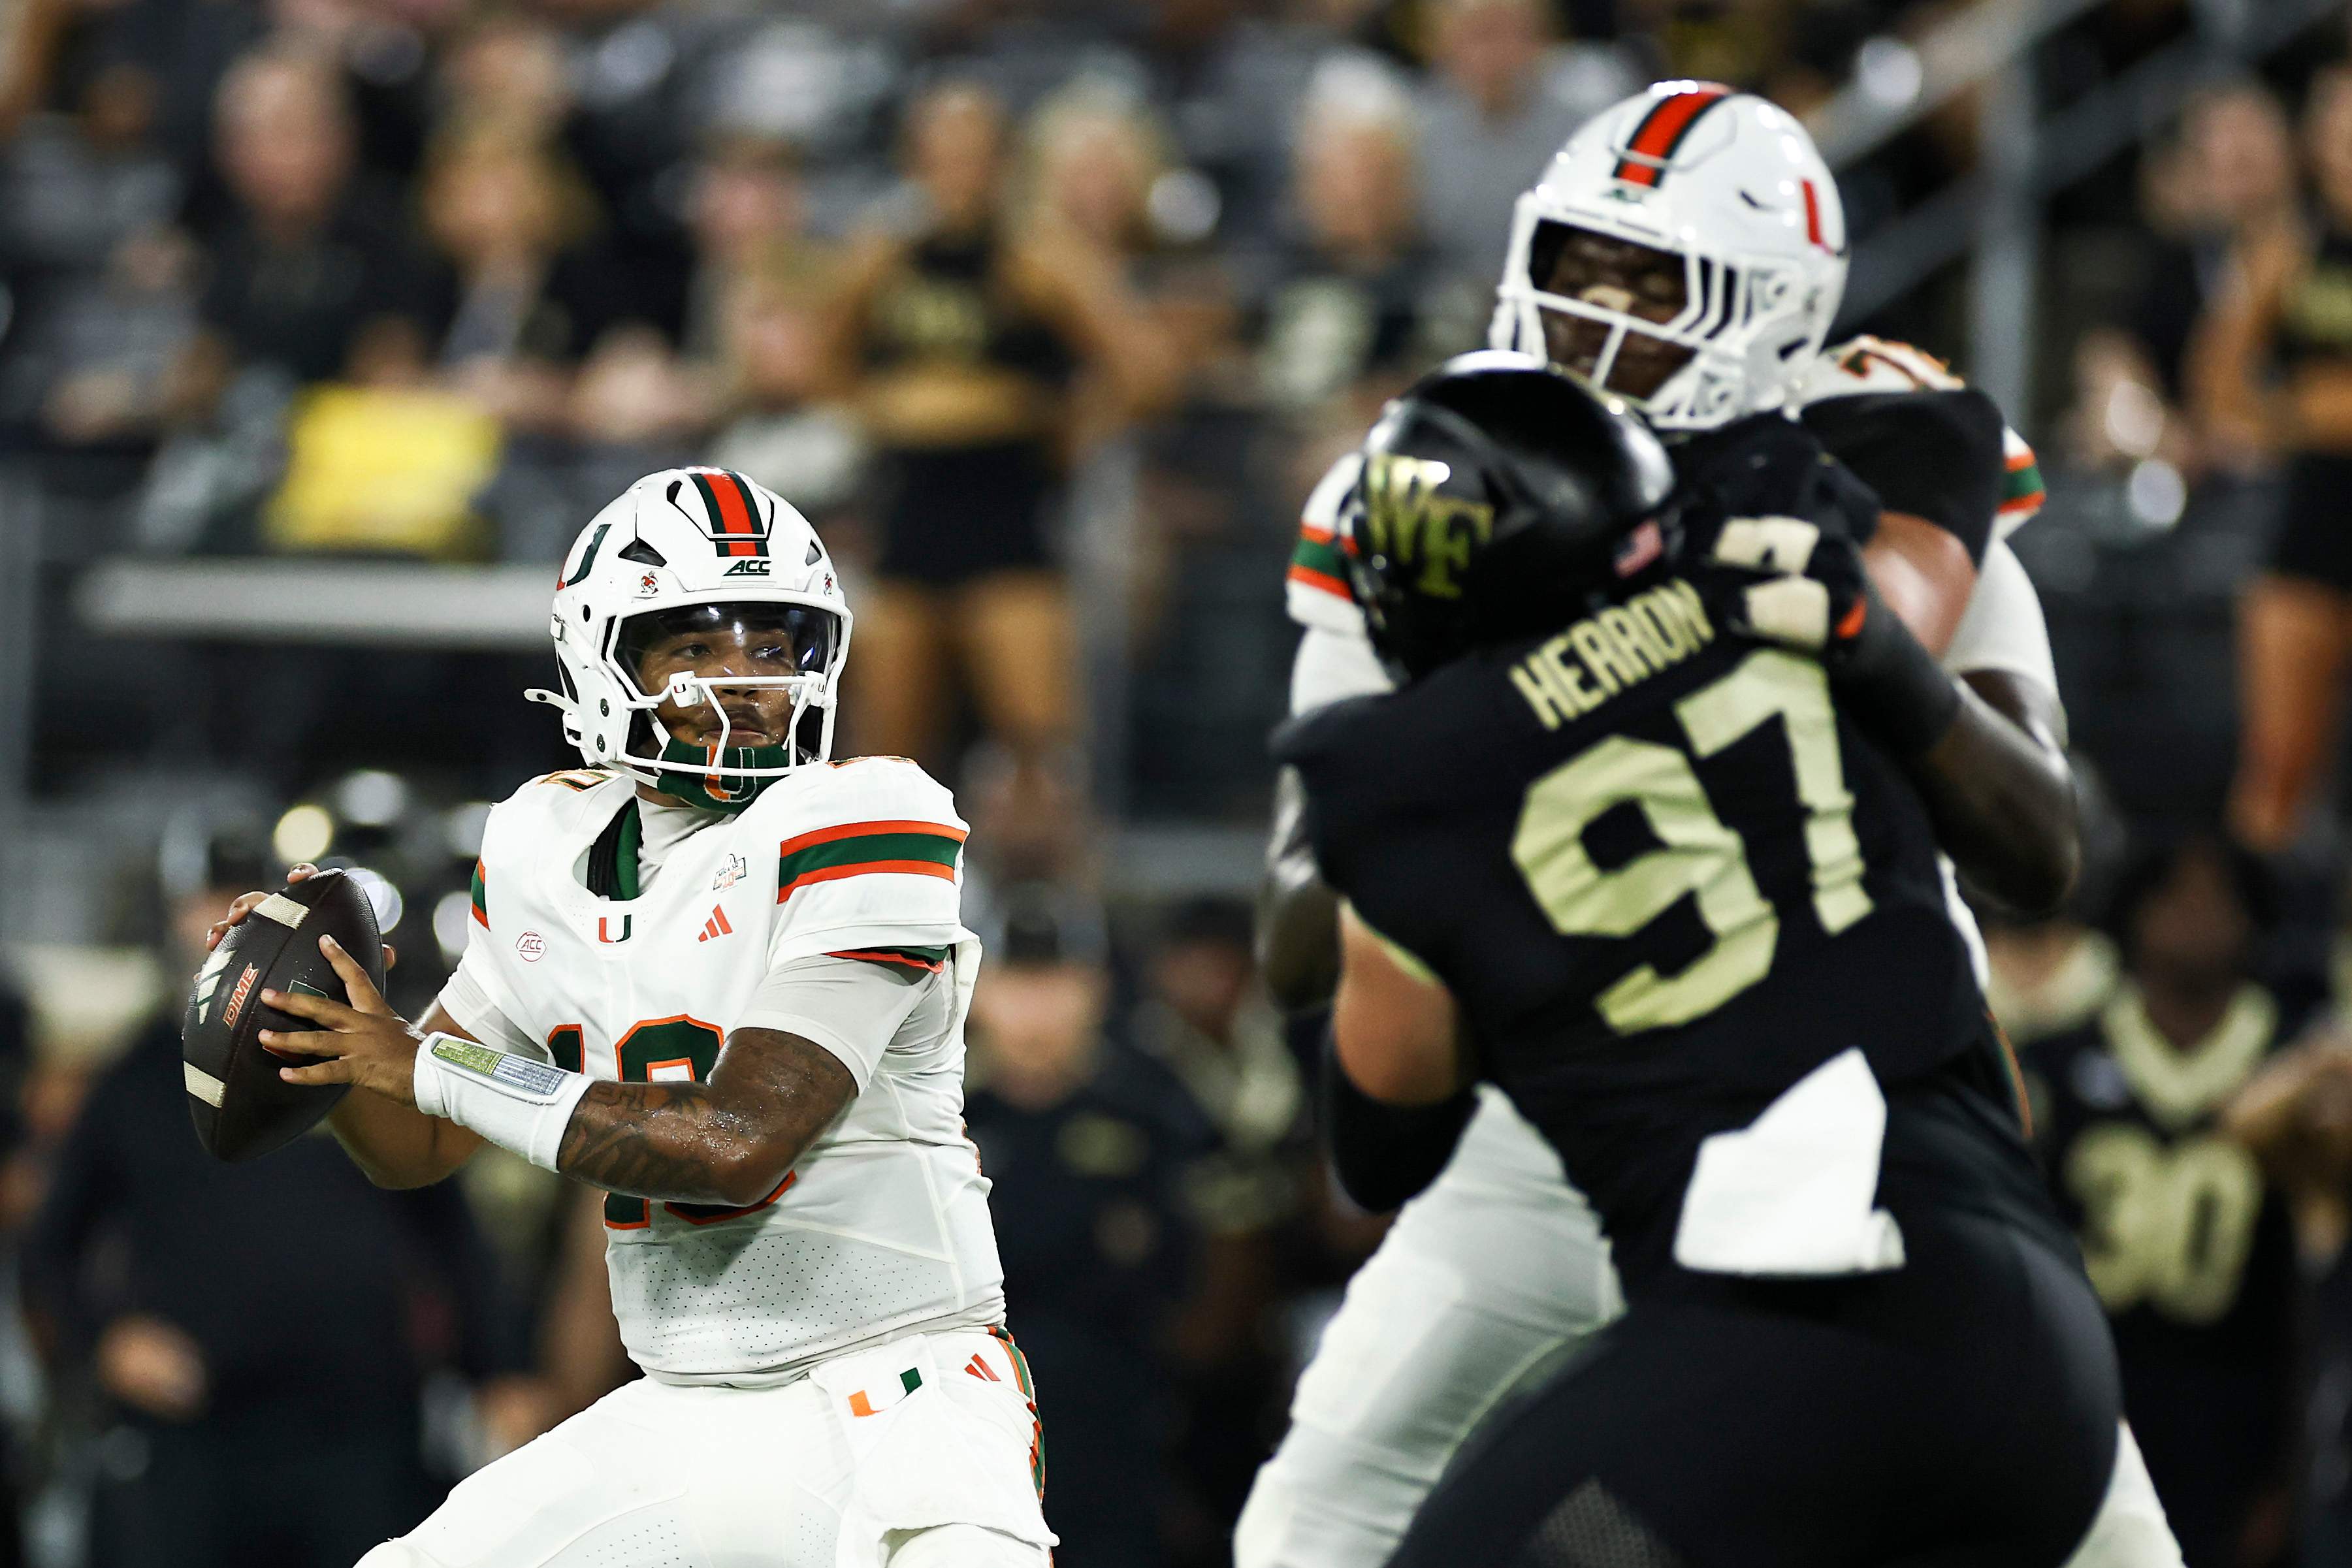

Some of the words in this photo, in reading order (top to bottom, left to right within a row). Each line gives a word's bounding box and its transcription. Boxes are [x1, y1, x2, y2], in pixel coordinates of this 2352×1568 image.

[726, 560, 772, 573] ACC
[1509, 578, 1715, 730] HERRON
[1510, 650, 1875, 1034] 97
[521, 938, 543, 950] ACC
[598, 914, 632, 943] U
[222, 962, 259, 1031] DIME
